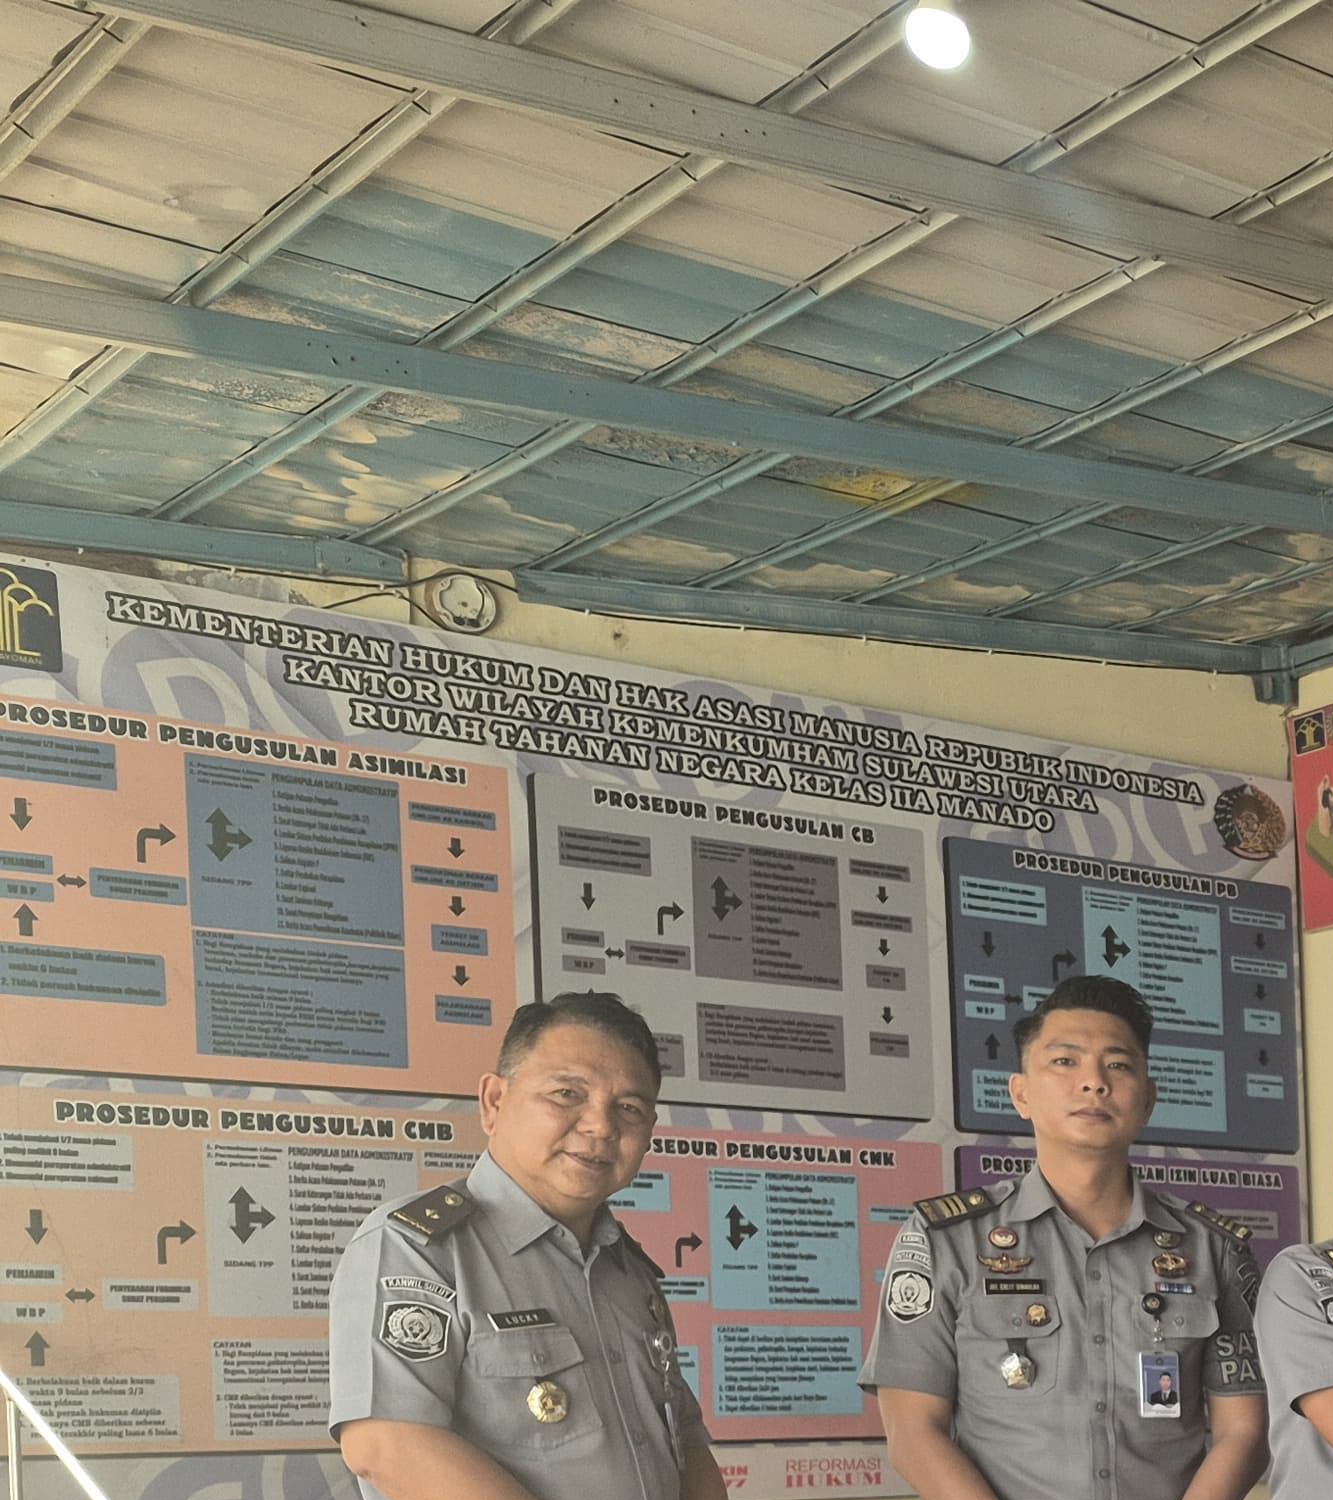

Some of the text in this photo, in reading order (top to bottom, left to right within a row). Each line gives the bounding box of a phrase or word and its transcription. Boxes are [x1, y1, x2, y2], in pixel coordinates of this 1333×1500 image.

[106, 592, 1204, 805] KEMENTERIAN HUKUM DAN HAK ASASI MANUSIA REPUBLIK INDONESIA
[159, 723, 338, 766] PENGUSULAN
[349, 752, 467, 784] ASIMILASI
[283, 655, 1098, 814] KANTOR WILAYAH KEMENKUMHAM SULAWESI UTARA
[350, 698, 1055, 833] RUMAH TAHANAN NEGARA KELAS IIA MANADO
[594, 787, 876, 845] PROSEDUR PENGUSULAN CB
[1014, 851, 1238, 898] PROSEDUR PENGUSULAN PB
[56, 1101, 454, 1142] PROSEDUR PENGUSULAN CMB
[341, 1149, 359, 1159] DATA
[726, 1143, 852, 1164] PENGUSULAN
[859, 1150, 896, 1167] CMK
[1170, 1167, 1197, 1182] IZIN
[1202, 1169, 1238, 1185] LUAR
[1242, 1172, 1283, 1188] BIASA
[505, 1313, 539, 1325] LUCKY
[785, 1458, 881, 1473] REFORMASI
[785, 1471, 882, 1488] HUKUM
